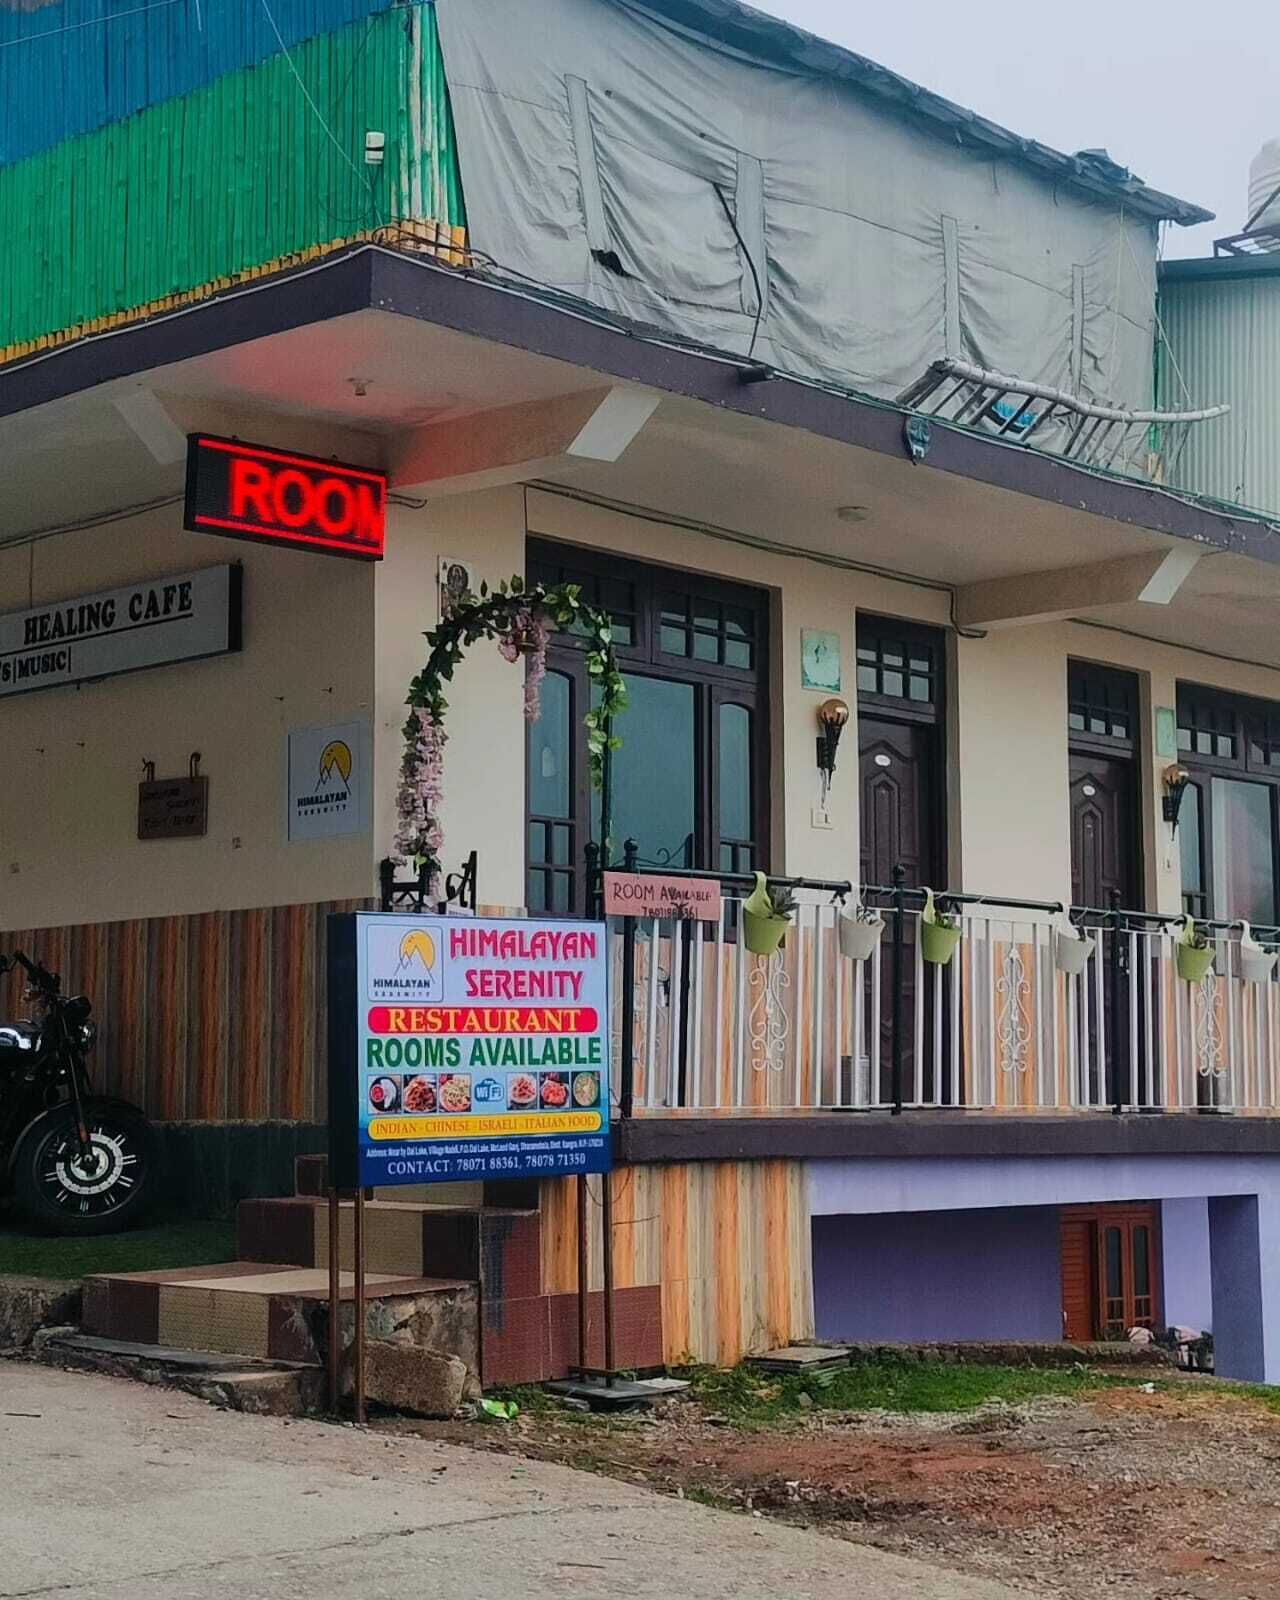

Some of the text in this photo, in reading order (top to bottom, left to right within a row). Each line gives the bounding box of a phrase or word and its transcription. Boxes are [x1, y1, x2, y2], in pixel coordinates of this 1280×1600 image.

[24, 581, 193, 645] HEALING CAFE
[297, 791, 348, 808] HIMALAYAN
[613, 882, 655, 901] ROOM
[450, 928, 596, 960] HIMALAYAN
[373, 978, 431, 989] HIMALAYAN
[465, 969, 584, 1001] SERENITY
[387, 1008, 582, 1033] RESTAURANT
[366, 1037, 602, 1068] ROOMS AVAILABLE
[375, 1114, 596, 1134] INDIAN CHINESE ISRAELI ITALIAN FOOD
[457, 1158, 486, 1171] 78071
[525, 1154, 554, 1168] 78078
[557, 1152, 586, 1166] 71350
